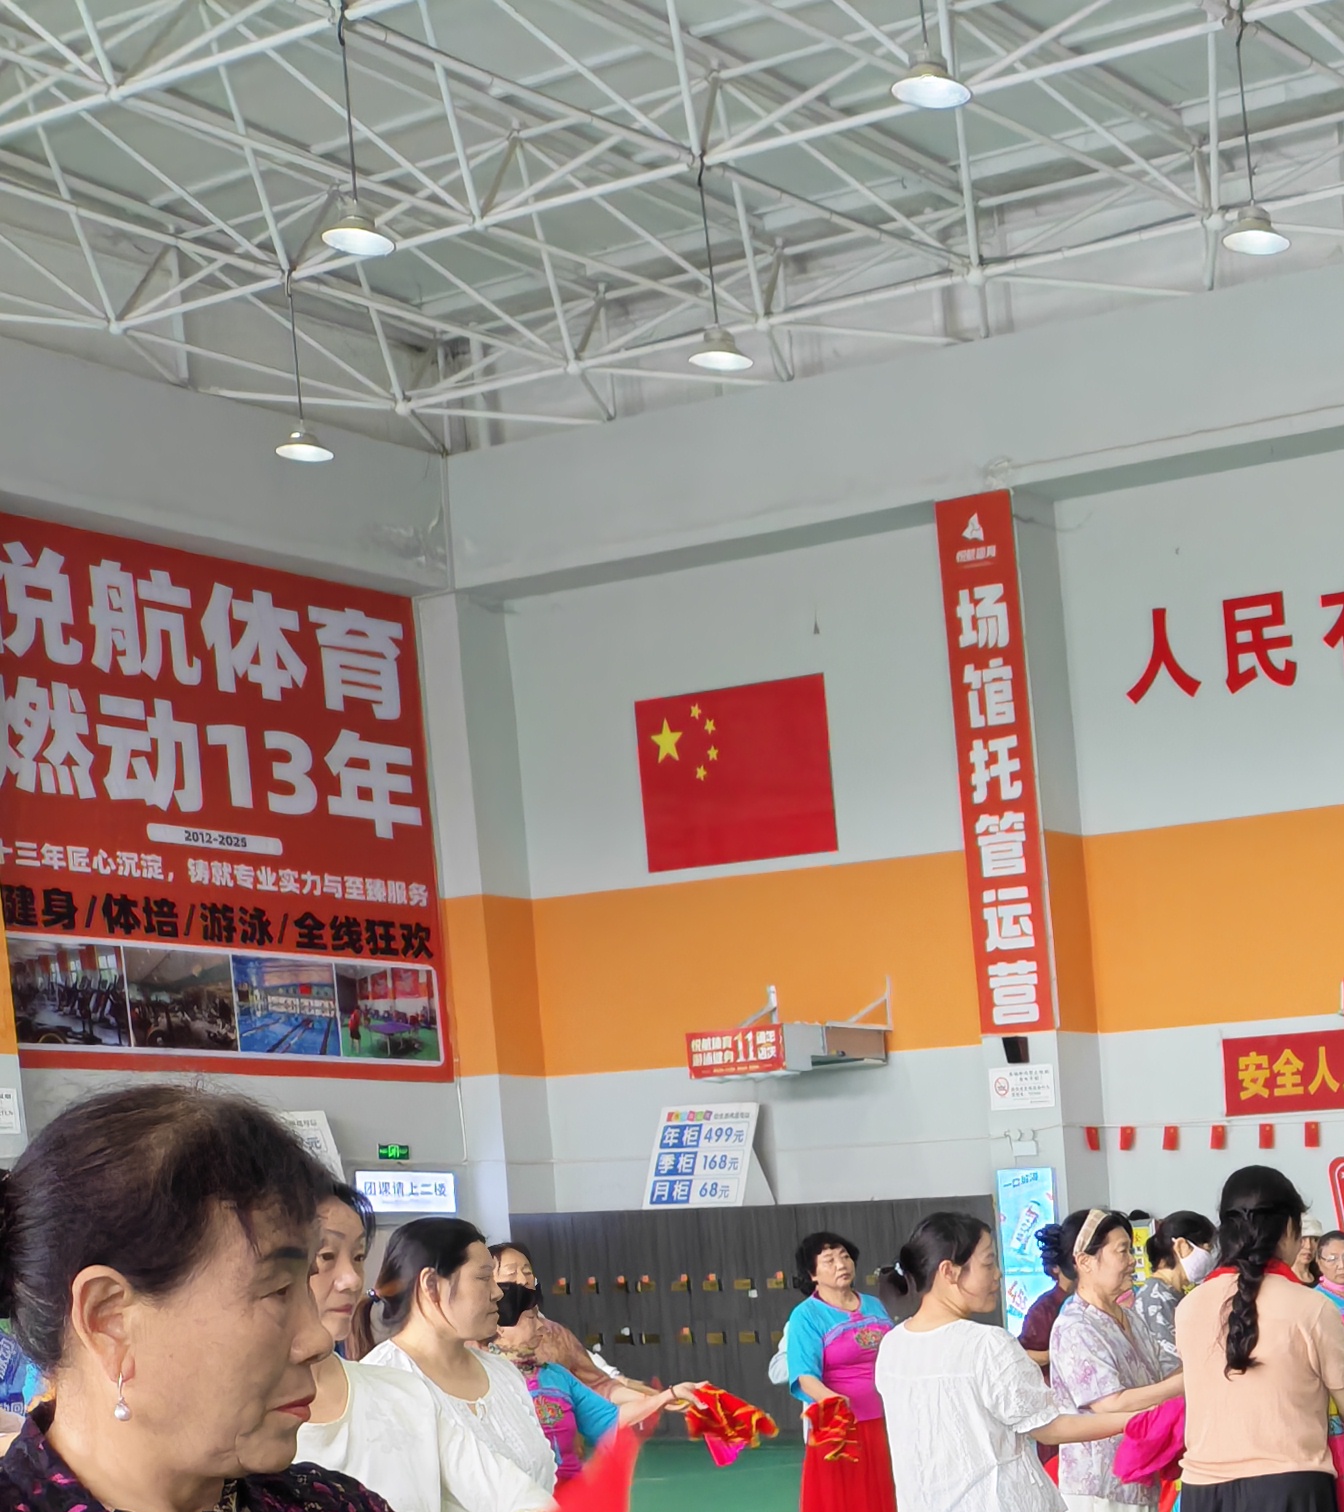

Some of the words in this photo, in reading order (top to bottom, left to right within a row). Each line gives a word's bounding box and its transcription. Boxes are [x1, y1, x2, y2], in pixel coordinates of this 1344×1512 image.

[0, 674, 422, 839] 燃动13年
[956, 584, 1039, 1026] 场馆托管运营
[184, 830, 248, 849] 2012-2025
[733, 1030, 757, 1063] 11
[663, 1126, 699, 1147] 年柜
[704, 1126, 744, 1144] 499元
[657, 1153, 695, 1174] 季柜
[702, 1154, 739, 1171] 168元
[652, 1180, 690, 1202] 月柜
[699, 1182, 730, 1199] 68元
